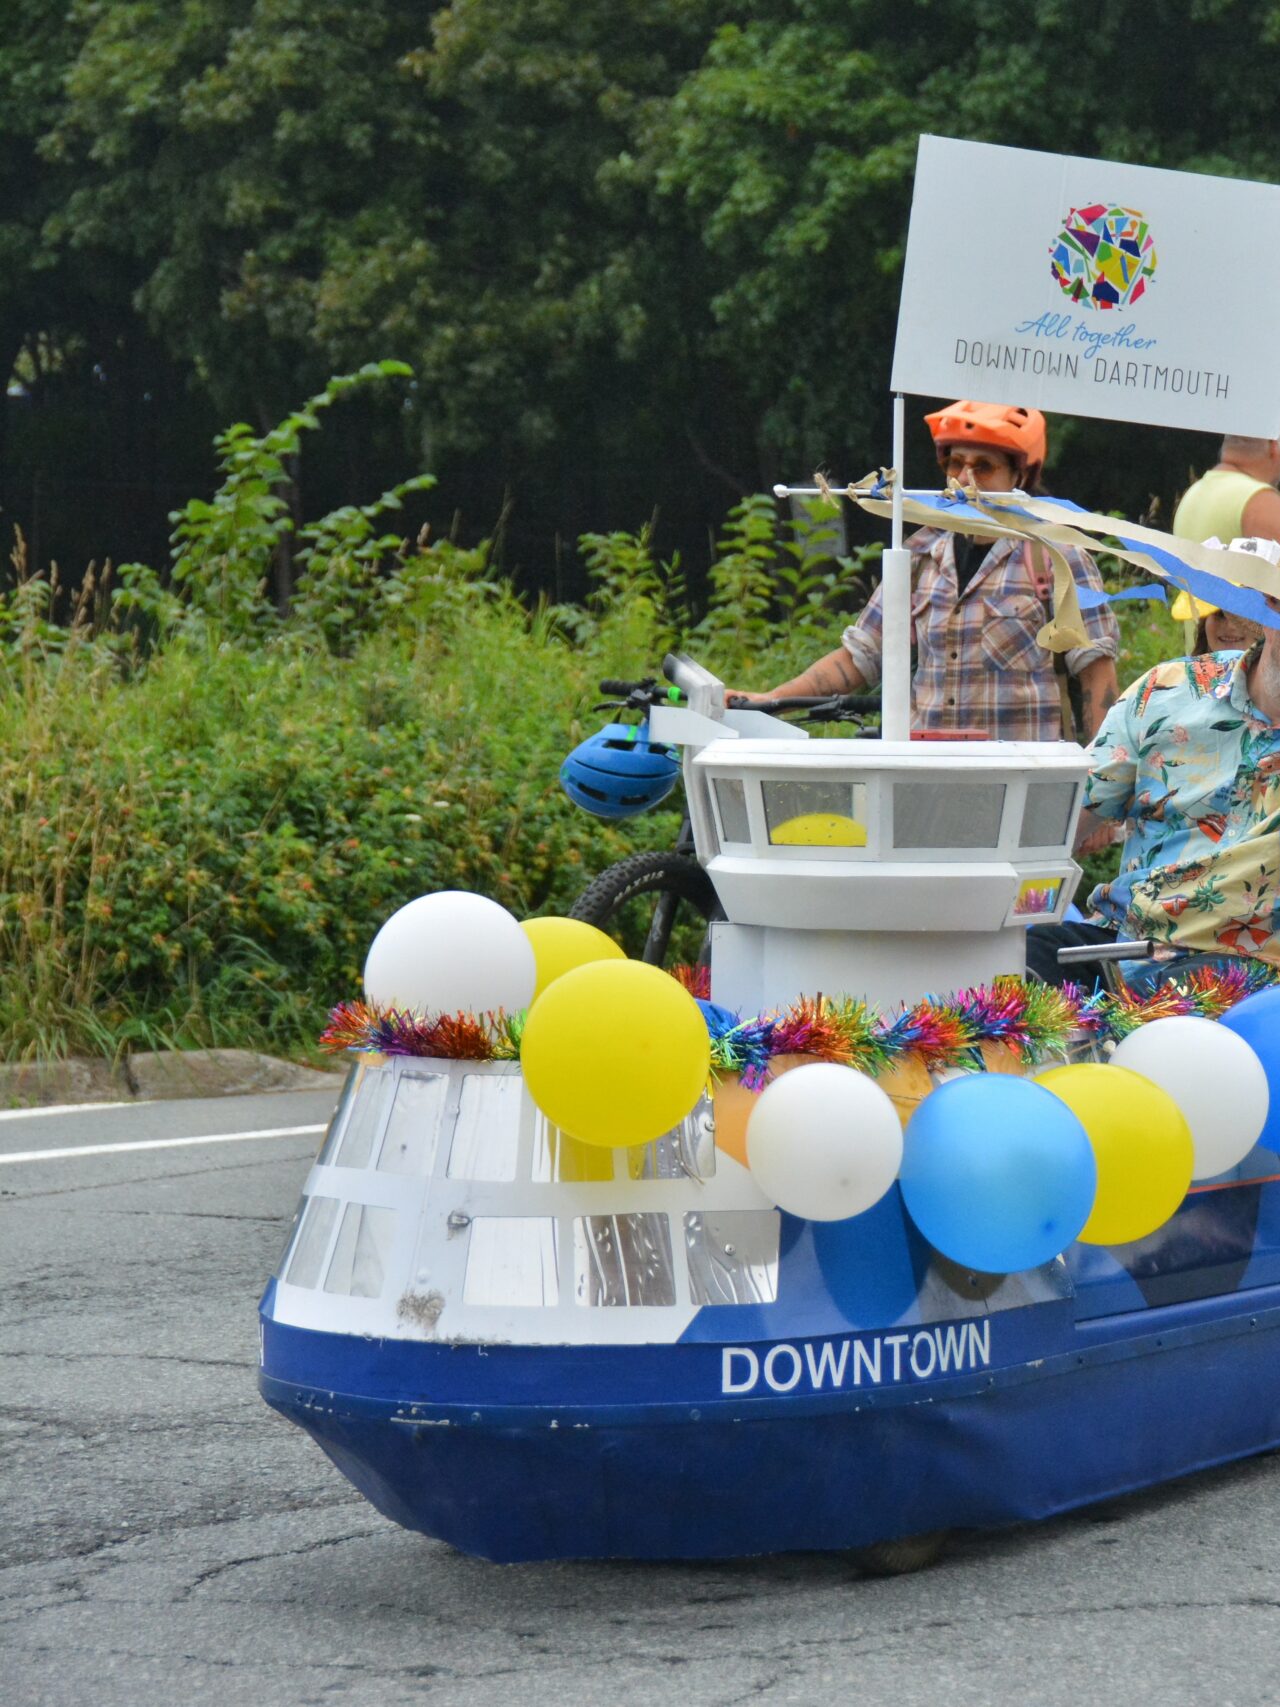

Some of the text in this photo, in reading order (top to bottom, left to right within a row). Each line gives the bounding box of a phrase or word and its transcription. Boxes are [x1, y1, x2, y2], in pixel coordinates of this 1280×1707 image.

[1015, 311, 1158, 360] All together
[954, 338, 1230, 400] DOWNTOWN DARTMOUTH
[720, 1319, 991, 1394] DOWNTOWN
